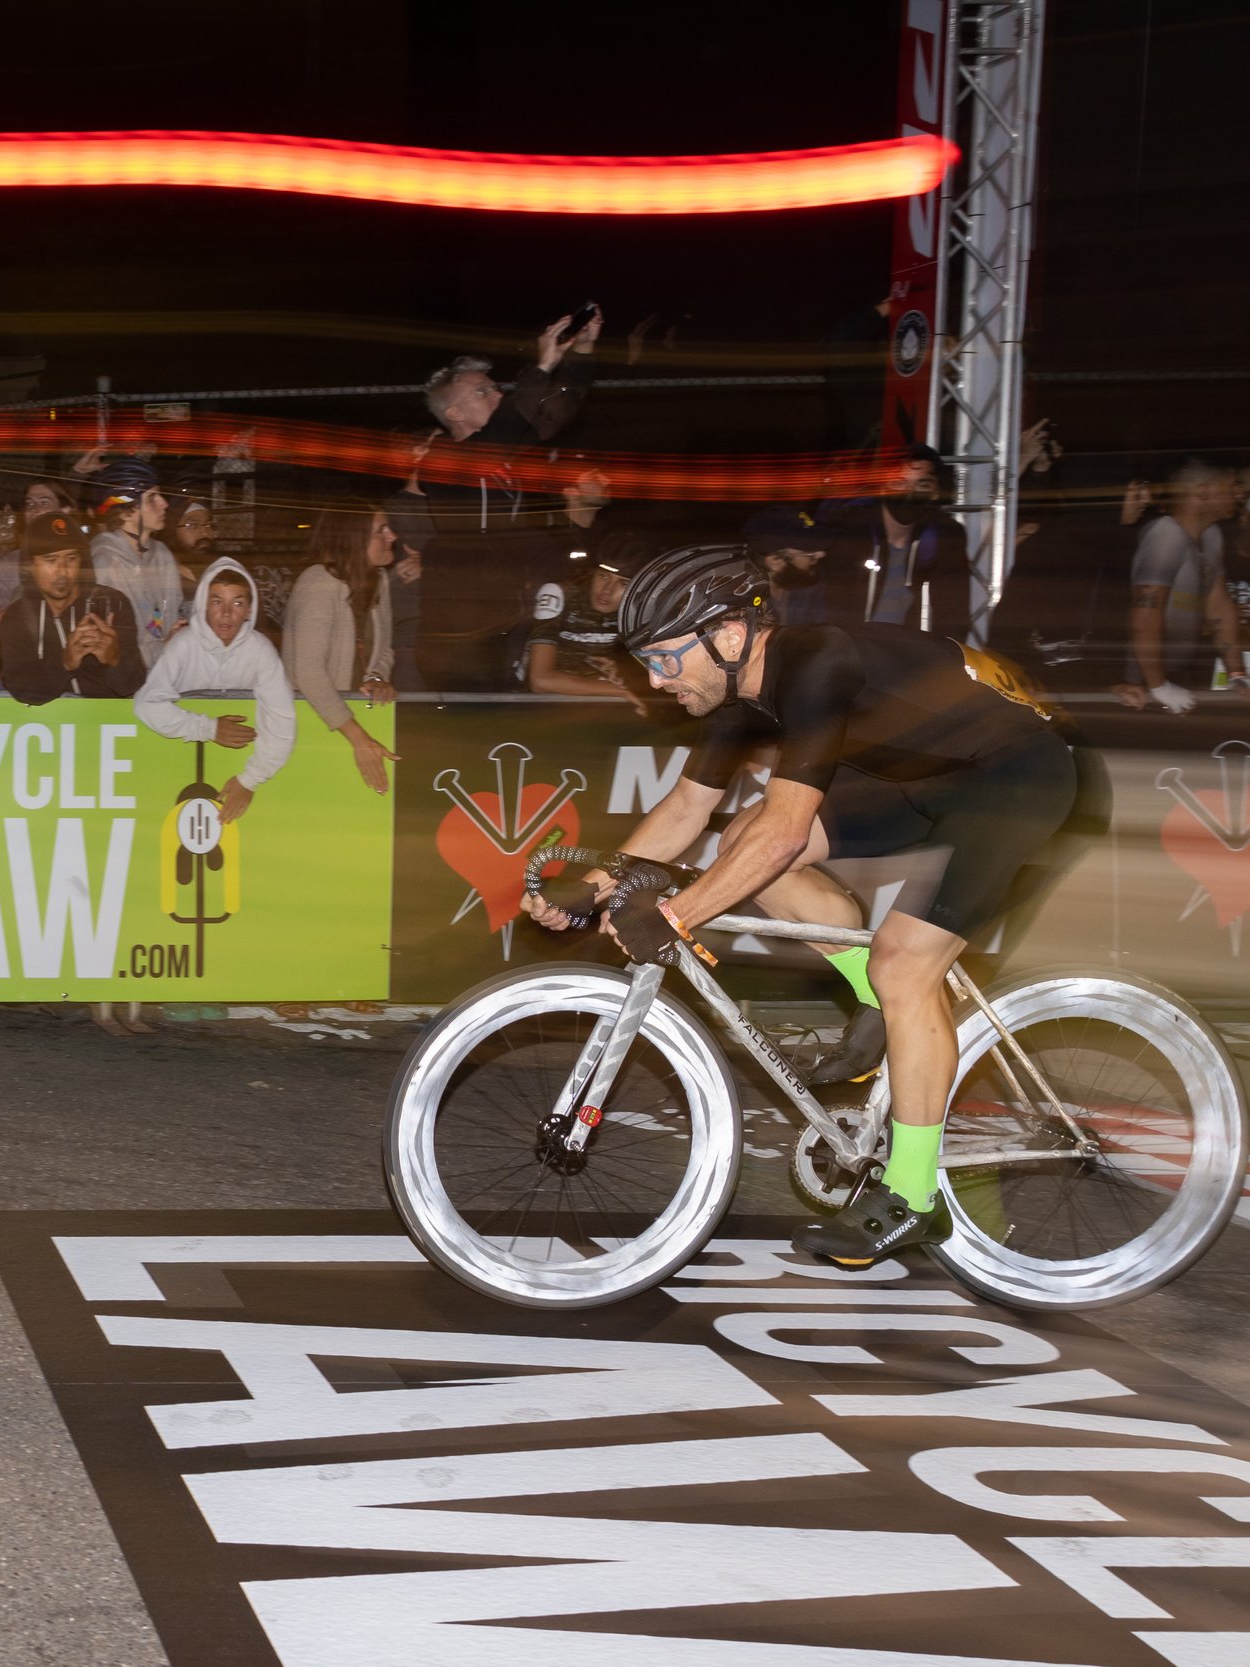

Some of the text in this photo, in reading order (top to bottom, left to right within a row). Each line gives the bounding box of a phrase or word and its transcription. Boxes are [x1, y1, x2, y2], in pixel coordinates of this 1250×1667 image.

[118, 944, 190, 978] .COM
[738, 1013, 806, 1095] FALCONER
[875, 1215, 918, 1251] S-WORKS
[51, 1235, 1110, 1667] LAW
[588, 1236, 1250, 1667] BICYCL
